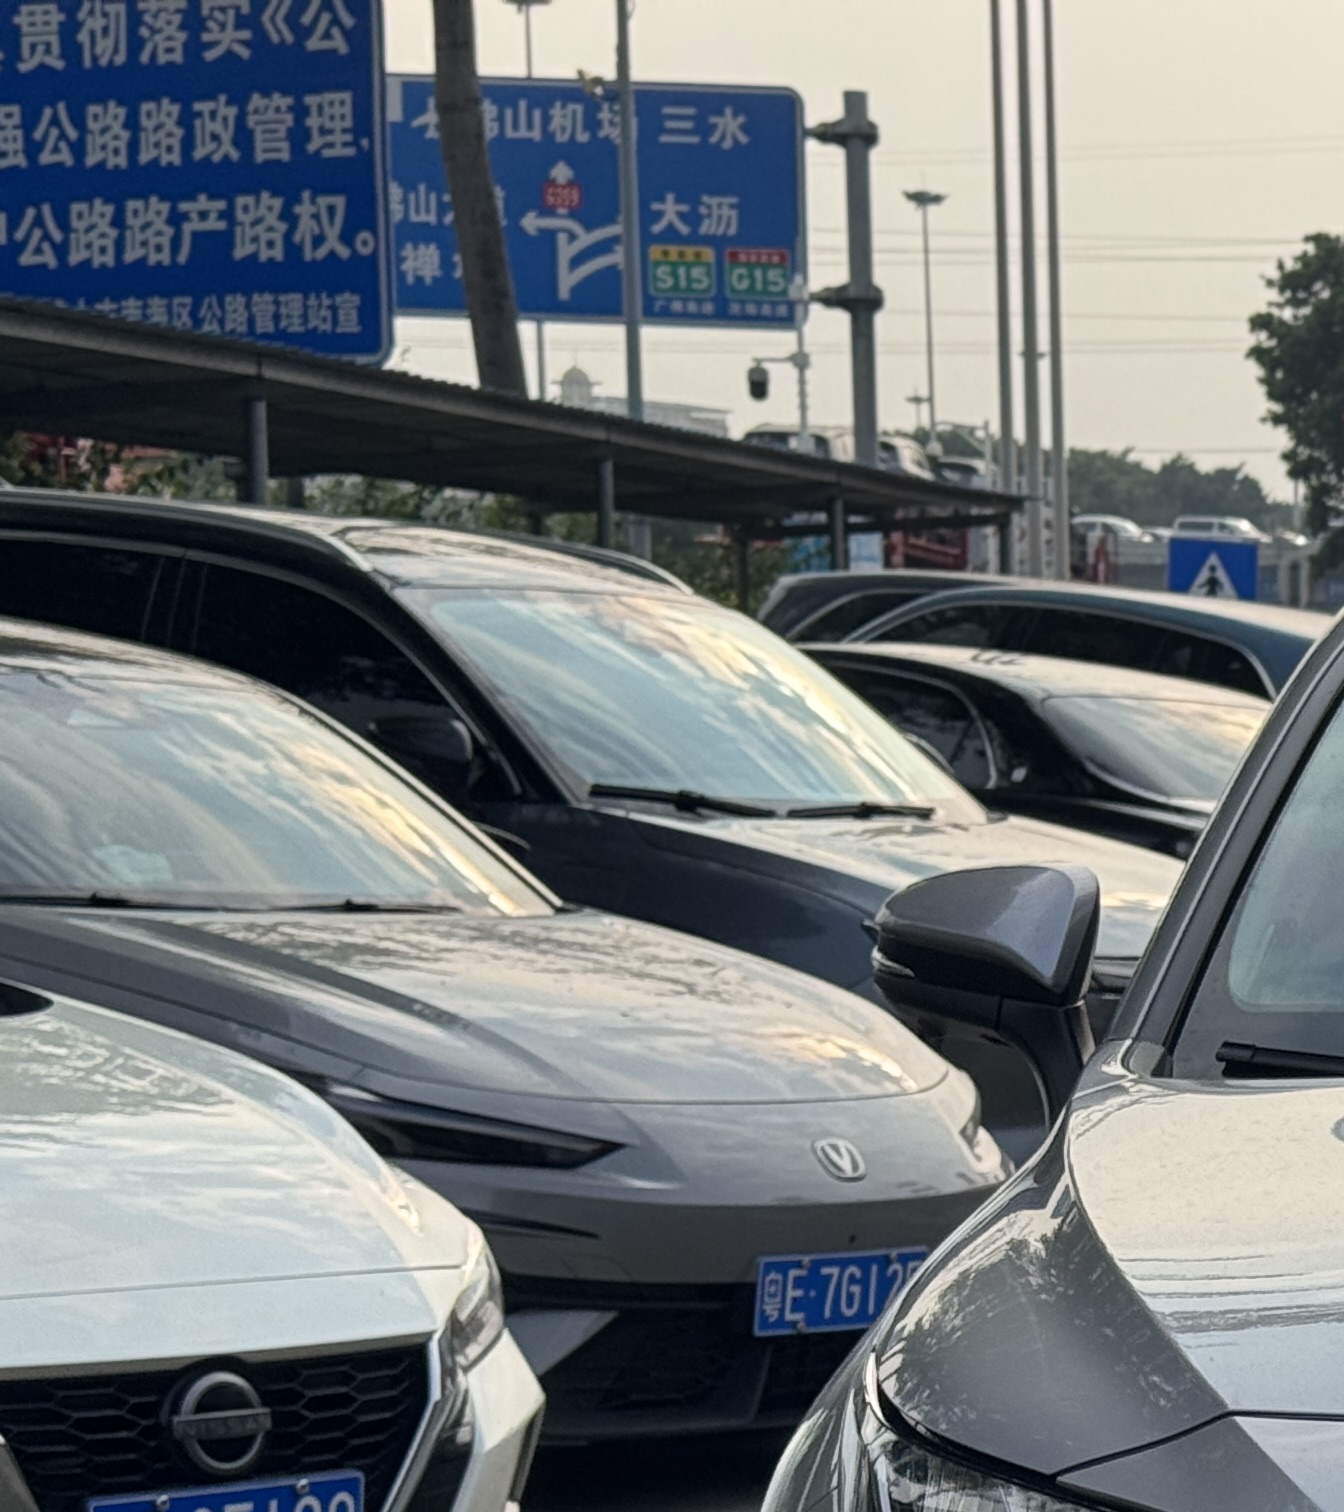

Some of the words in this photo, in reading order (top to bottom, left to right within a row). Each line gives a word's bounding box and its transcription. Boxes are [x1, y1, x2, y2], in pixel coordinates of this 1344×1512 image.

[0, 0, 357, 74] 贯彻落实《公
[658, 104, 750, 150] 三水
[0, 187, 377, 271] 公路路产路权。
[650, 192, 740, 238] 大沥
[401, 242, 465, 286] 禅
[655, 264, 711, 291] S15
[730, 267, 786, 294] G15
